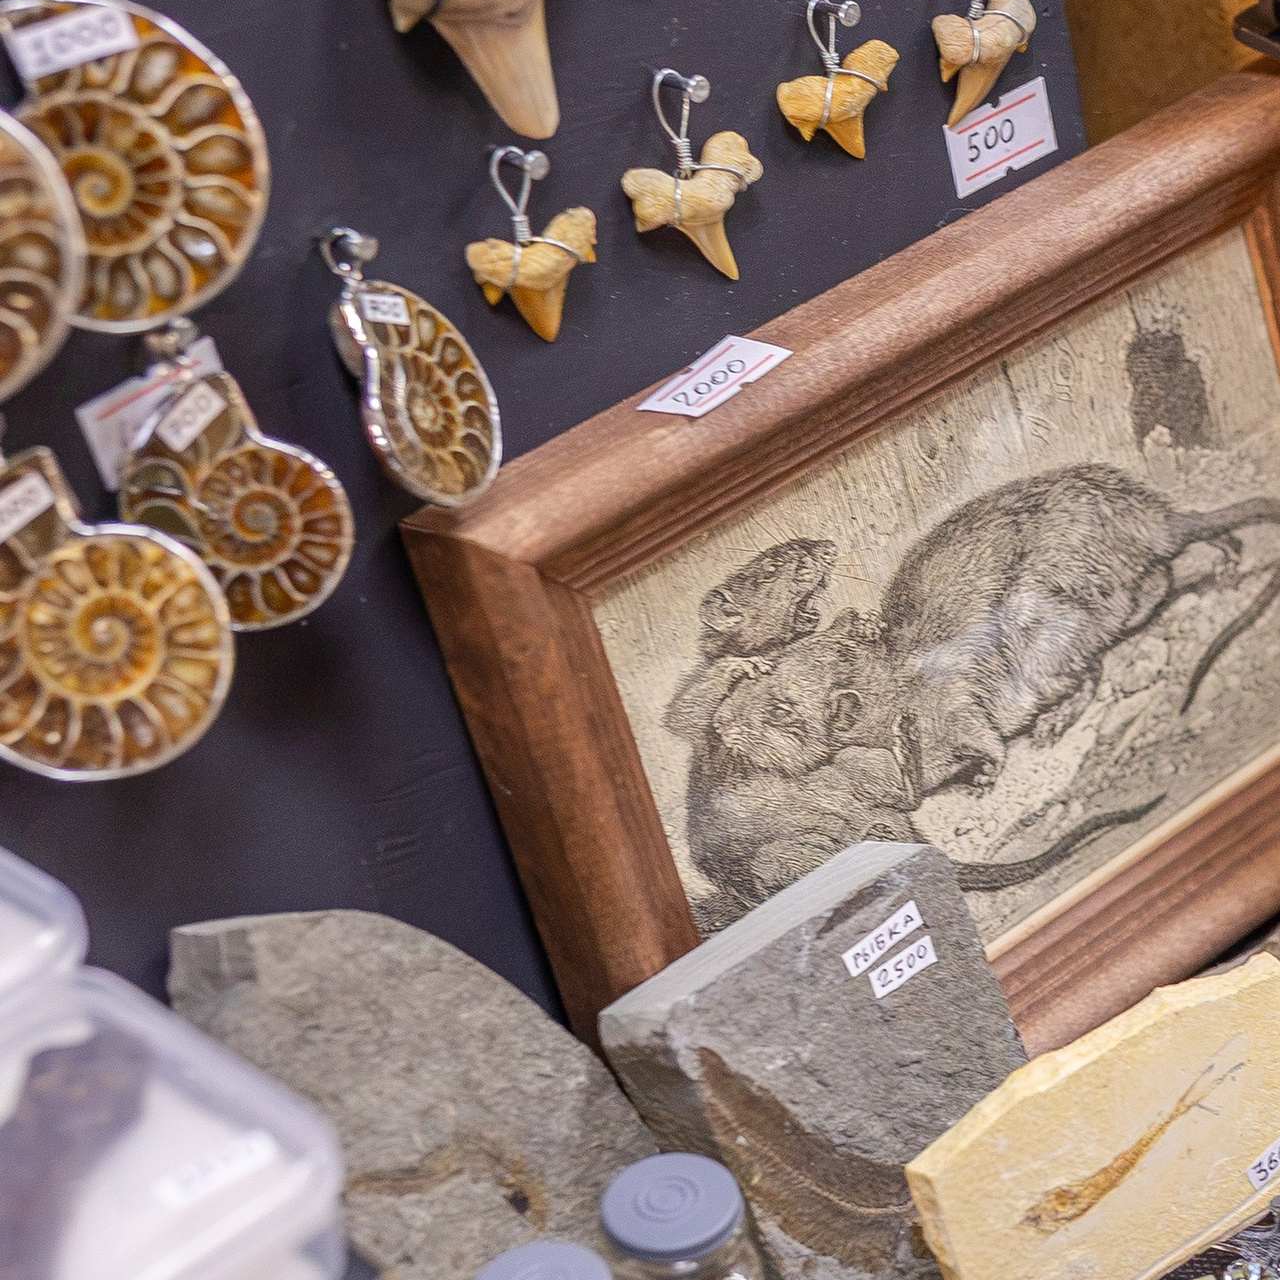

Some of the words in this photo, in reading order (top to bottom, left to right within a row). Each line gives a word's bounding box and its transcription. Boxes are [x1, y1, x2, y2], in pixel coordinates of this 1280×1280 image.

[967, 119, 1015, 162] 500
[672, 359, 746, 406] 2000
[852, 914, 915, 968] РЫБКА
[877, 944, 928, 988] 2500
